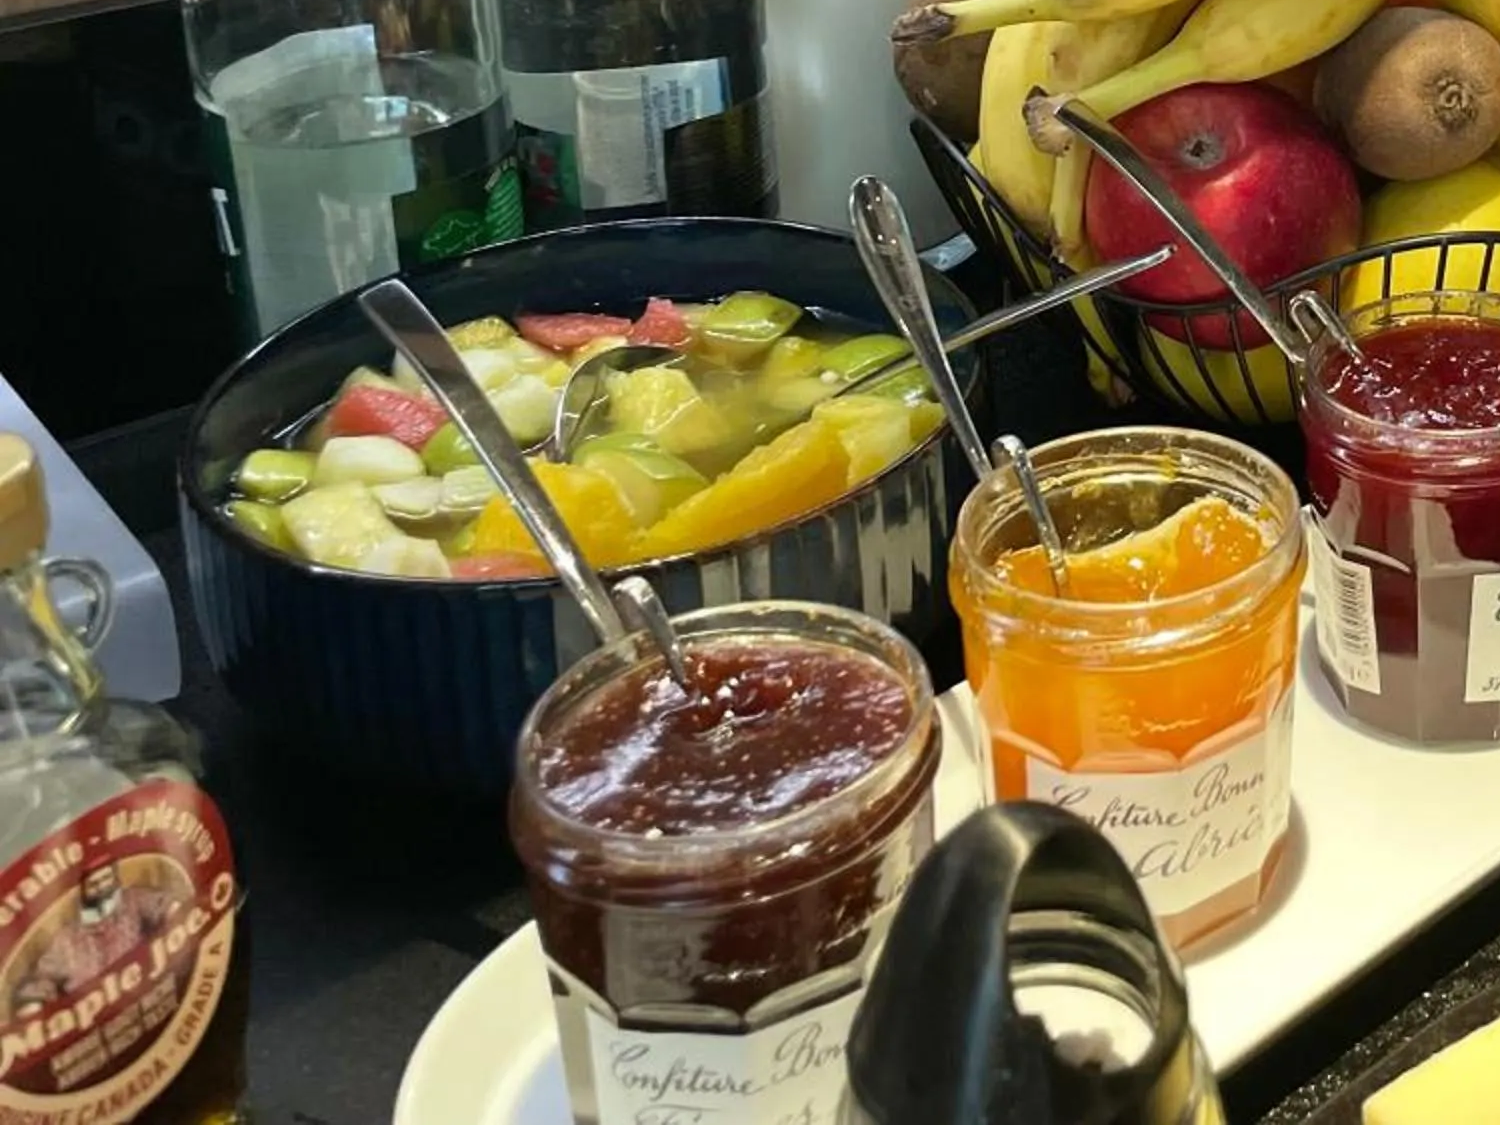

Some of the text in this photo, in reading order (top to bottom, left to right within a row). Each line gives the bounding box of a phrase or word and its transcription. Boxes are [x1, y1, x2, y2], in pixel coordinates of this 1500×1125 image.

[1190, 762, 1265, 818] Bonn
[106, 799, 176, 843] Maple
[0, 962, 142, 1076] Maple
[176, 967, 220, 1046] GRADE
[208, 940, 224, 955] A
[610, 1041, 767, 1102] Confiture
